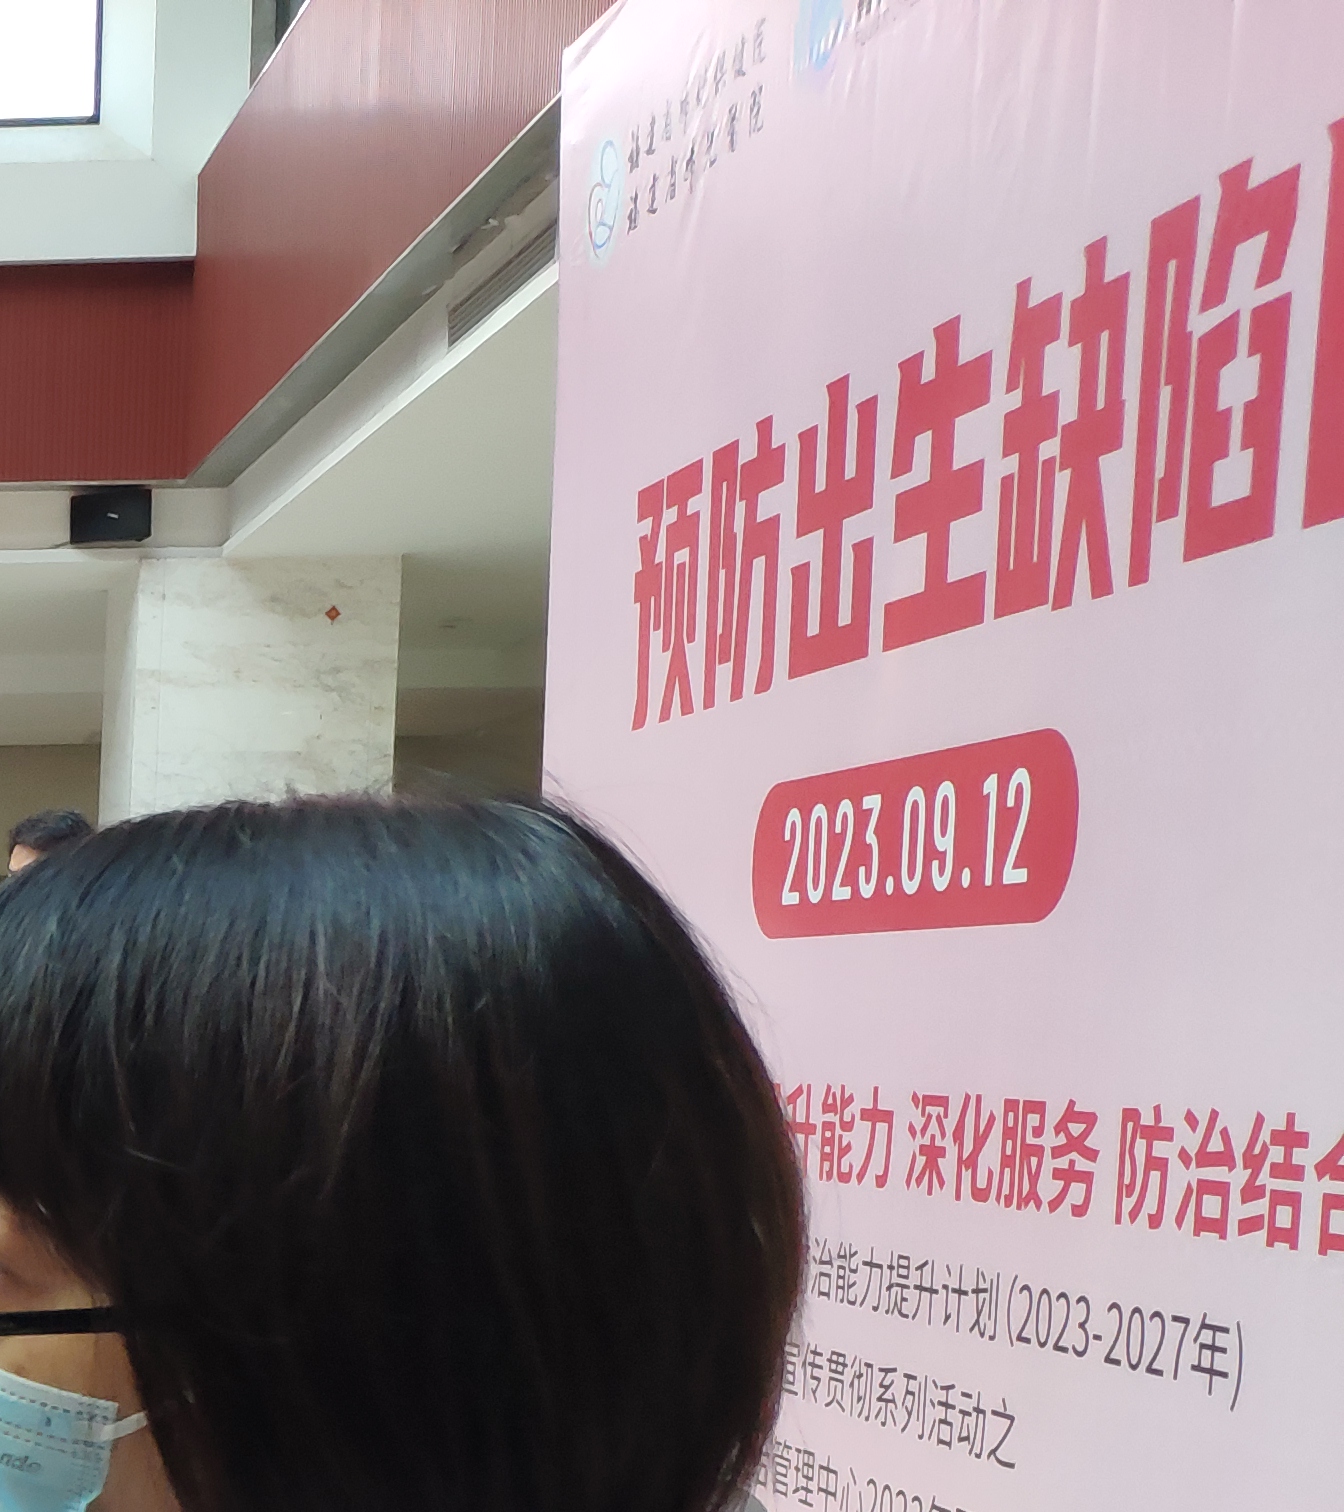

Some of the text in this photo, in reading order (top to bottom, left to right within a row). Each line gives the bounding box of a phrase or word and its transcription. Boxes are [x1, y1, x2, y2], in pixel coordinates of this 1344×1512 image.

[632, 119, 1344, 731] 预防出生缺陷
[779, 767, 1033, 907] 2023.09.12
[775, 1083, 898, 1190] 升能力
[904, 1089, 1101, 1219] 深化服务
[806, 1238, 1245, 1411] 治能力提升计划(2023-2027年)
